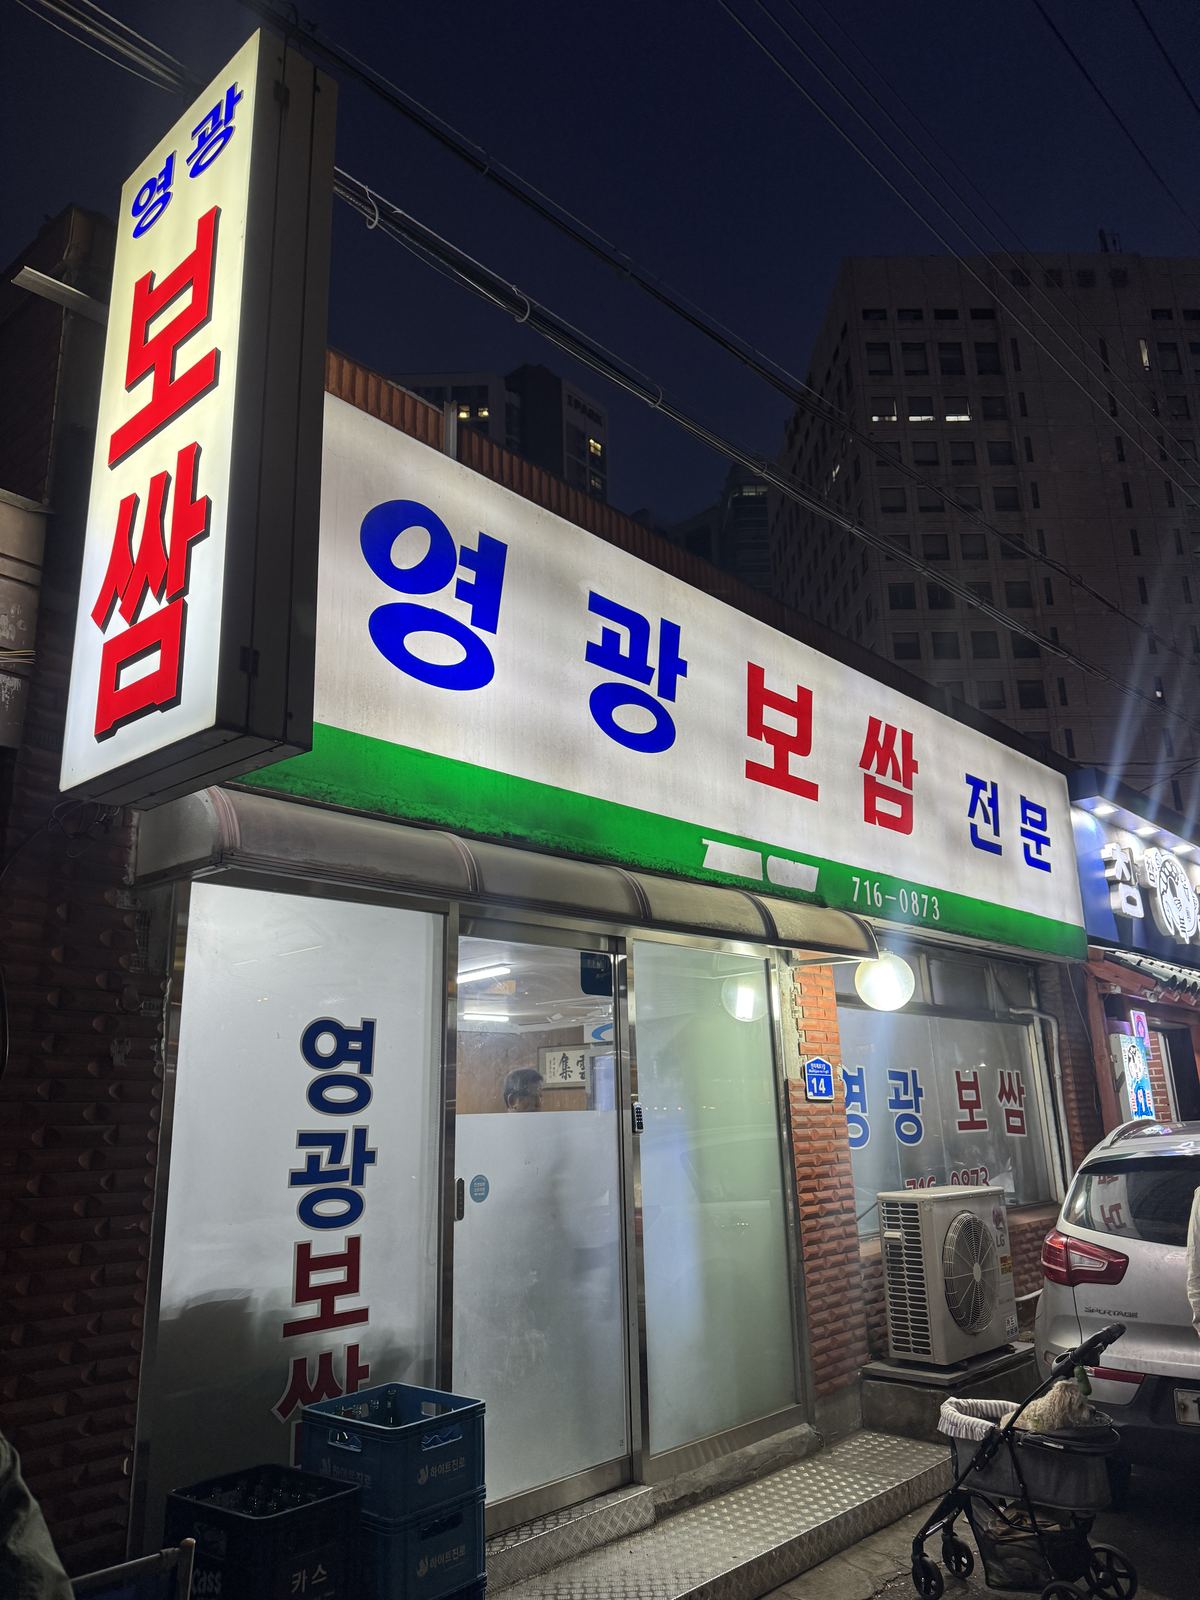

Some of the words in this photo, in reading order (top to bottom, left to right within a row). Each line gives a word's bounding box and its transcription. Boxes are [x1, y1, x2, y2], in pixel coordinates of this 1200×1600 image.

[132, 81, 244, 239] 영광
[91, 205, 222, 744] 보쌈
[360, 499, 688, 754] 영광
[745, 661, 919, 836] 보쌈
[965, 773, 1052, 873] 전문
[852, 876, 940, 921] 716-0873
[811, 1077, 826, 1094] 14
[954, 1068, 1027, 1136] 보쌈
[996, 1234, 1006, 1247] LG
[1084, 1306, 1138, 1319] SPORTAGE
[291, 1563, 328, 1593] 카스
